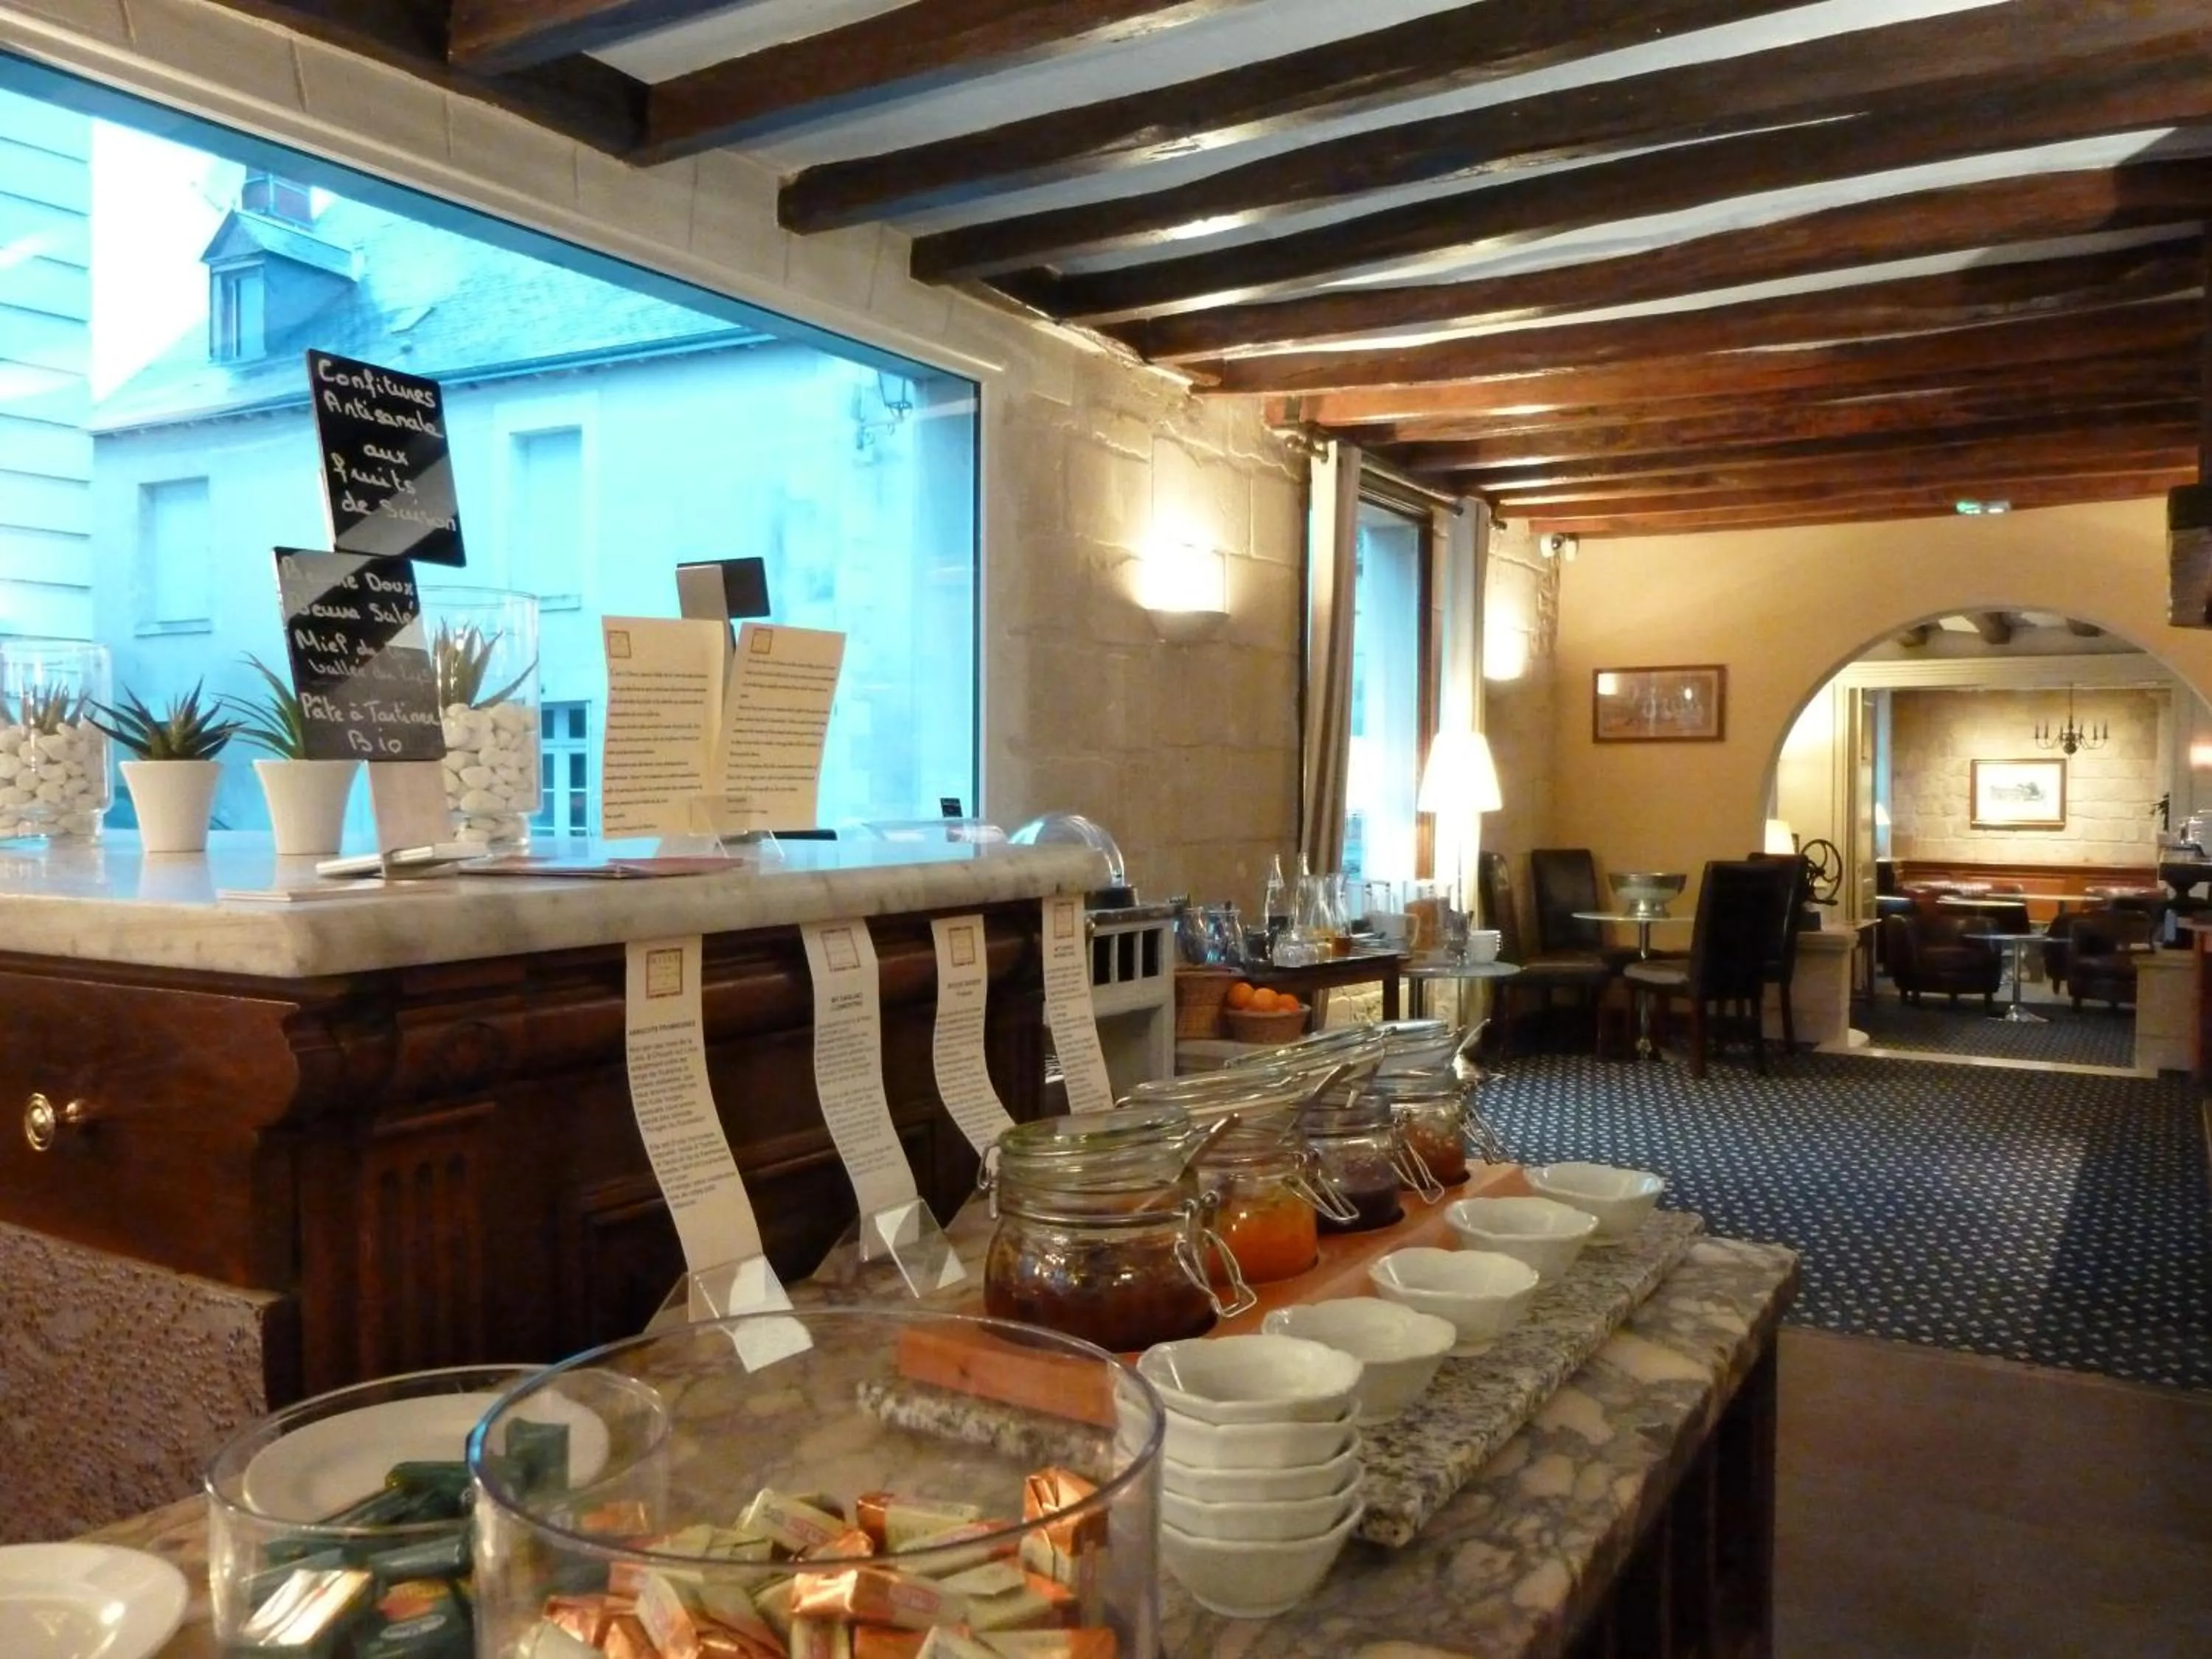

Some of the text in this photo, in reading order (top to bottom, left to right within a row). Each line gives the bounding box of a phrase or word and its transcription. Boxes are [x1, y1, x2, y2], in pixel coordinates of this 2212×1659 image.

[318, 358, 437, 408] Confitures
[323, 389, 445, 439] Artisanale
[363, 444, 409, 466] aux
[341, 490, 372, 515] de
[364, 571, 414, 597] Doux
[369, 600, 414, 625] Salé
[294, 628, 349, 655] Miel
[299, 692, 345, 723] Pâte
[348, 702, 365, 722] à
[347, 726, 403, 754] Bio
